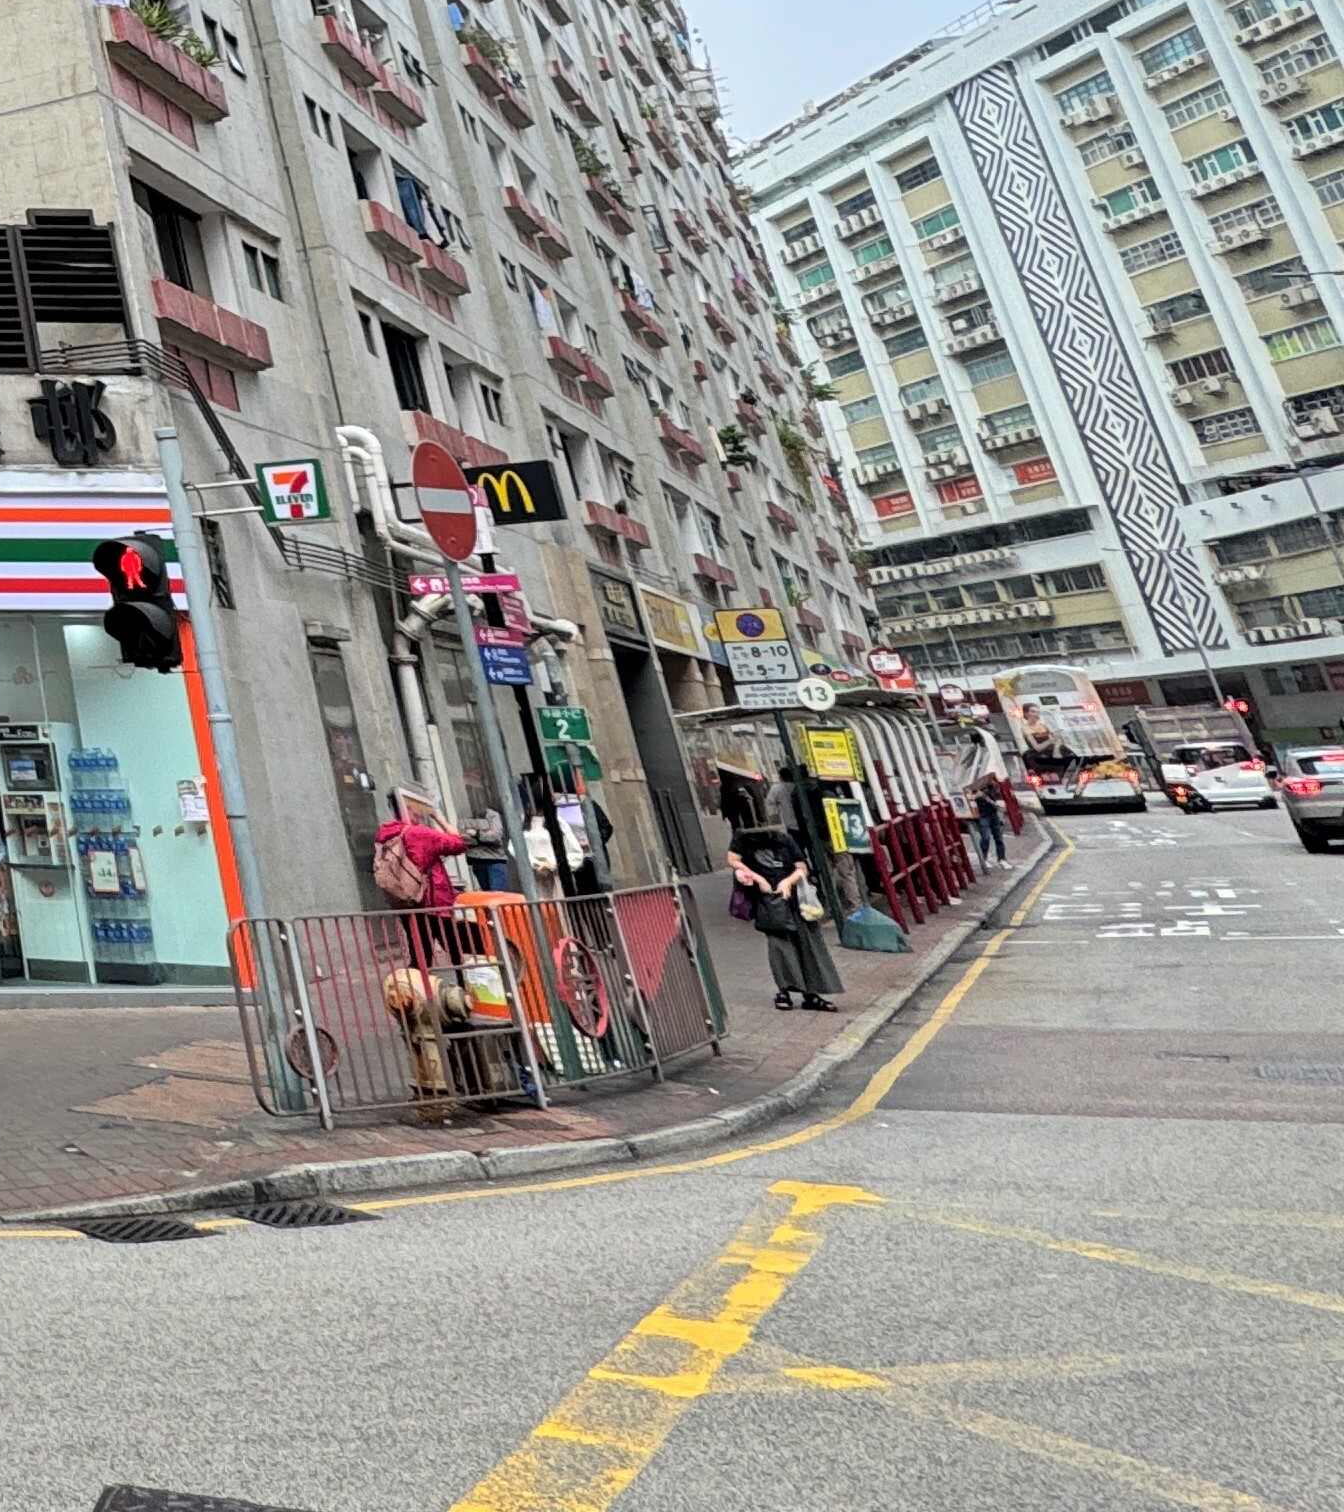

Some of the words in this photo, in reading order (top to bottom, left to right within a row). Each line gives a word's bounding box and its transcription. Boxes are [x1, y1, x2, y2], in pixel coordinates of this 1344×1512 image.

[272, 470, 309, 519] 7
[751, 645, 789, 658] 8-10
[803, 686, 830, 702] 13
[556, 719, 572, 739] 2
[840, 811, 868, 840] 13
